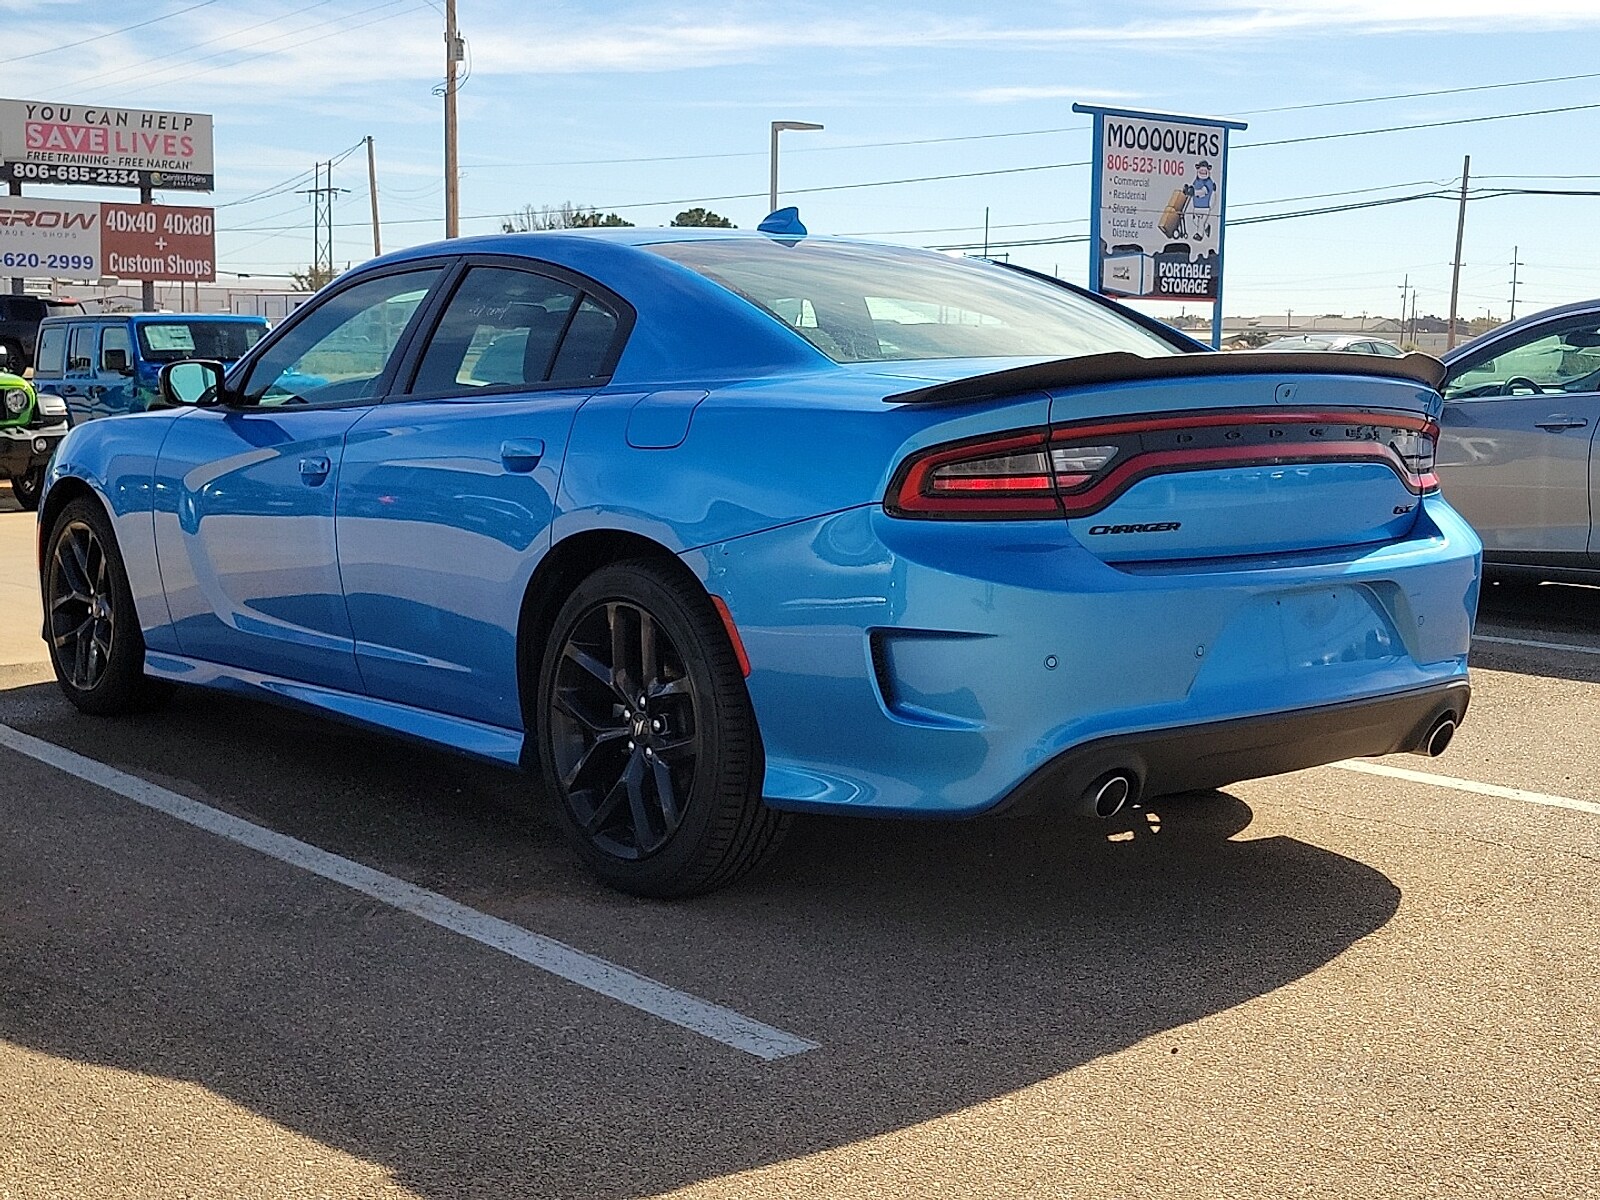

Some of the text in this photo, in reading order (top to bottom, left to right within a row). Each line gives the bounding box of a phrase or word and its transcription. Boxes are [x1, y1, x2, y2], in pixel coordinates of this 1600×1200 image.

[26, 105, 193, 131] YOU CAN HELP
[27, 123, 194, 157] SAVE LIVES
[1107, 123, 1219, 157] MOOOOVERS
[26, 151, 54, 162] FREE
[56, 153, 109, 165] TRAINING
[119, 157, 144, 167] FREE
[1107, 154, 1185, 176] 806-523-1006
[13, 163, 140, 184] 806-685-2334
[1113, 175, 1150, 188] Commercial
[1113, 189, 1147, 201] Residential
[106, 210, 212, 236] 40x40 40x80
[1112, 218, 1129, 228] Local
[1130, 219, 1137, 228] &
[1112, 228, 1139, 239] Distance
[155, 237, 168, 250] +
[109, 252, 211, 277] Custom Shops
[1159, 262, 1212, 279] PORTABLE
[1161, 278, 1209, 294] STORAGE
[1088, 522, 1182, 535] CHARGER
